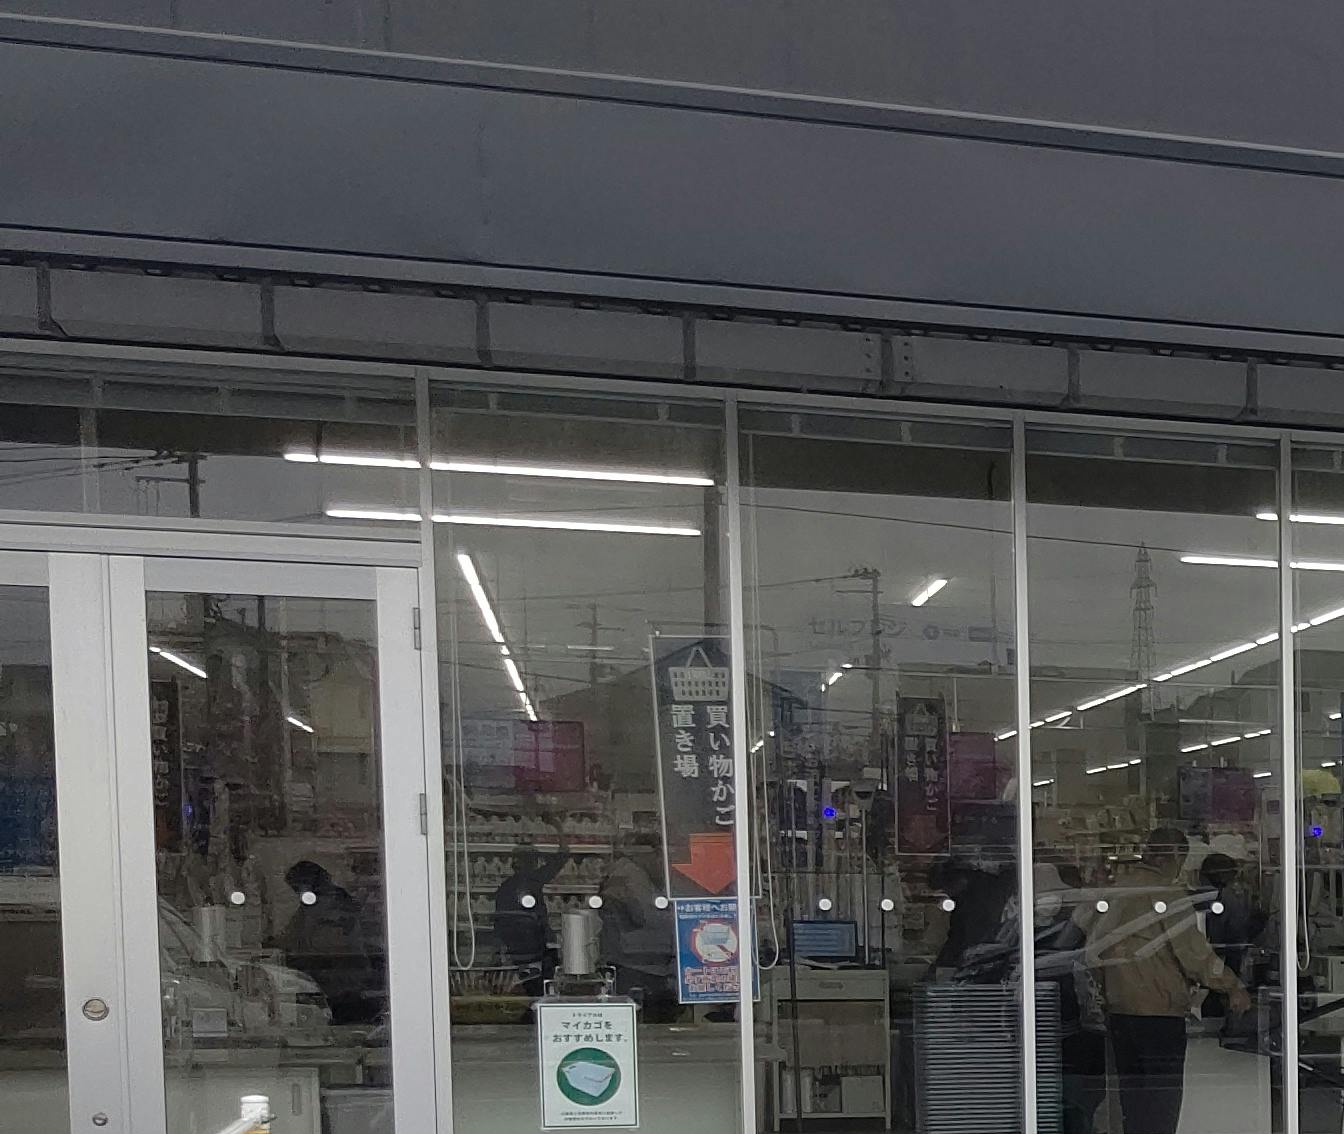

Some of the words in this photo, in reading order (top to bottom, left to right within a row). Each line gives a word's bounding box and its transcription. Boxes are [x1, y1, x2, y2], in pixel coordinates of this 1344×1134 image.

[671, 704, 699, 778] 置き場
[561, 1020, 613, 1030] マイカゴを
[552, 1033, 628, 1043] おすすめします。
